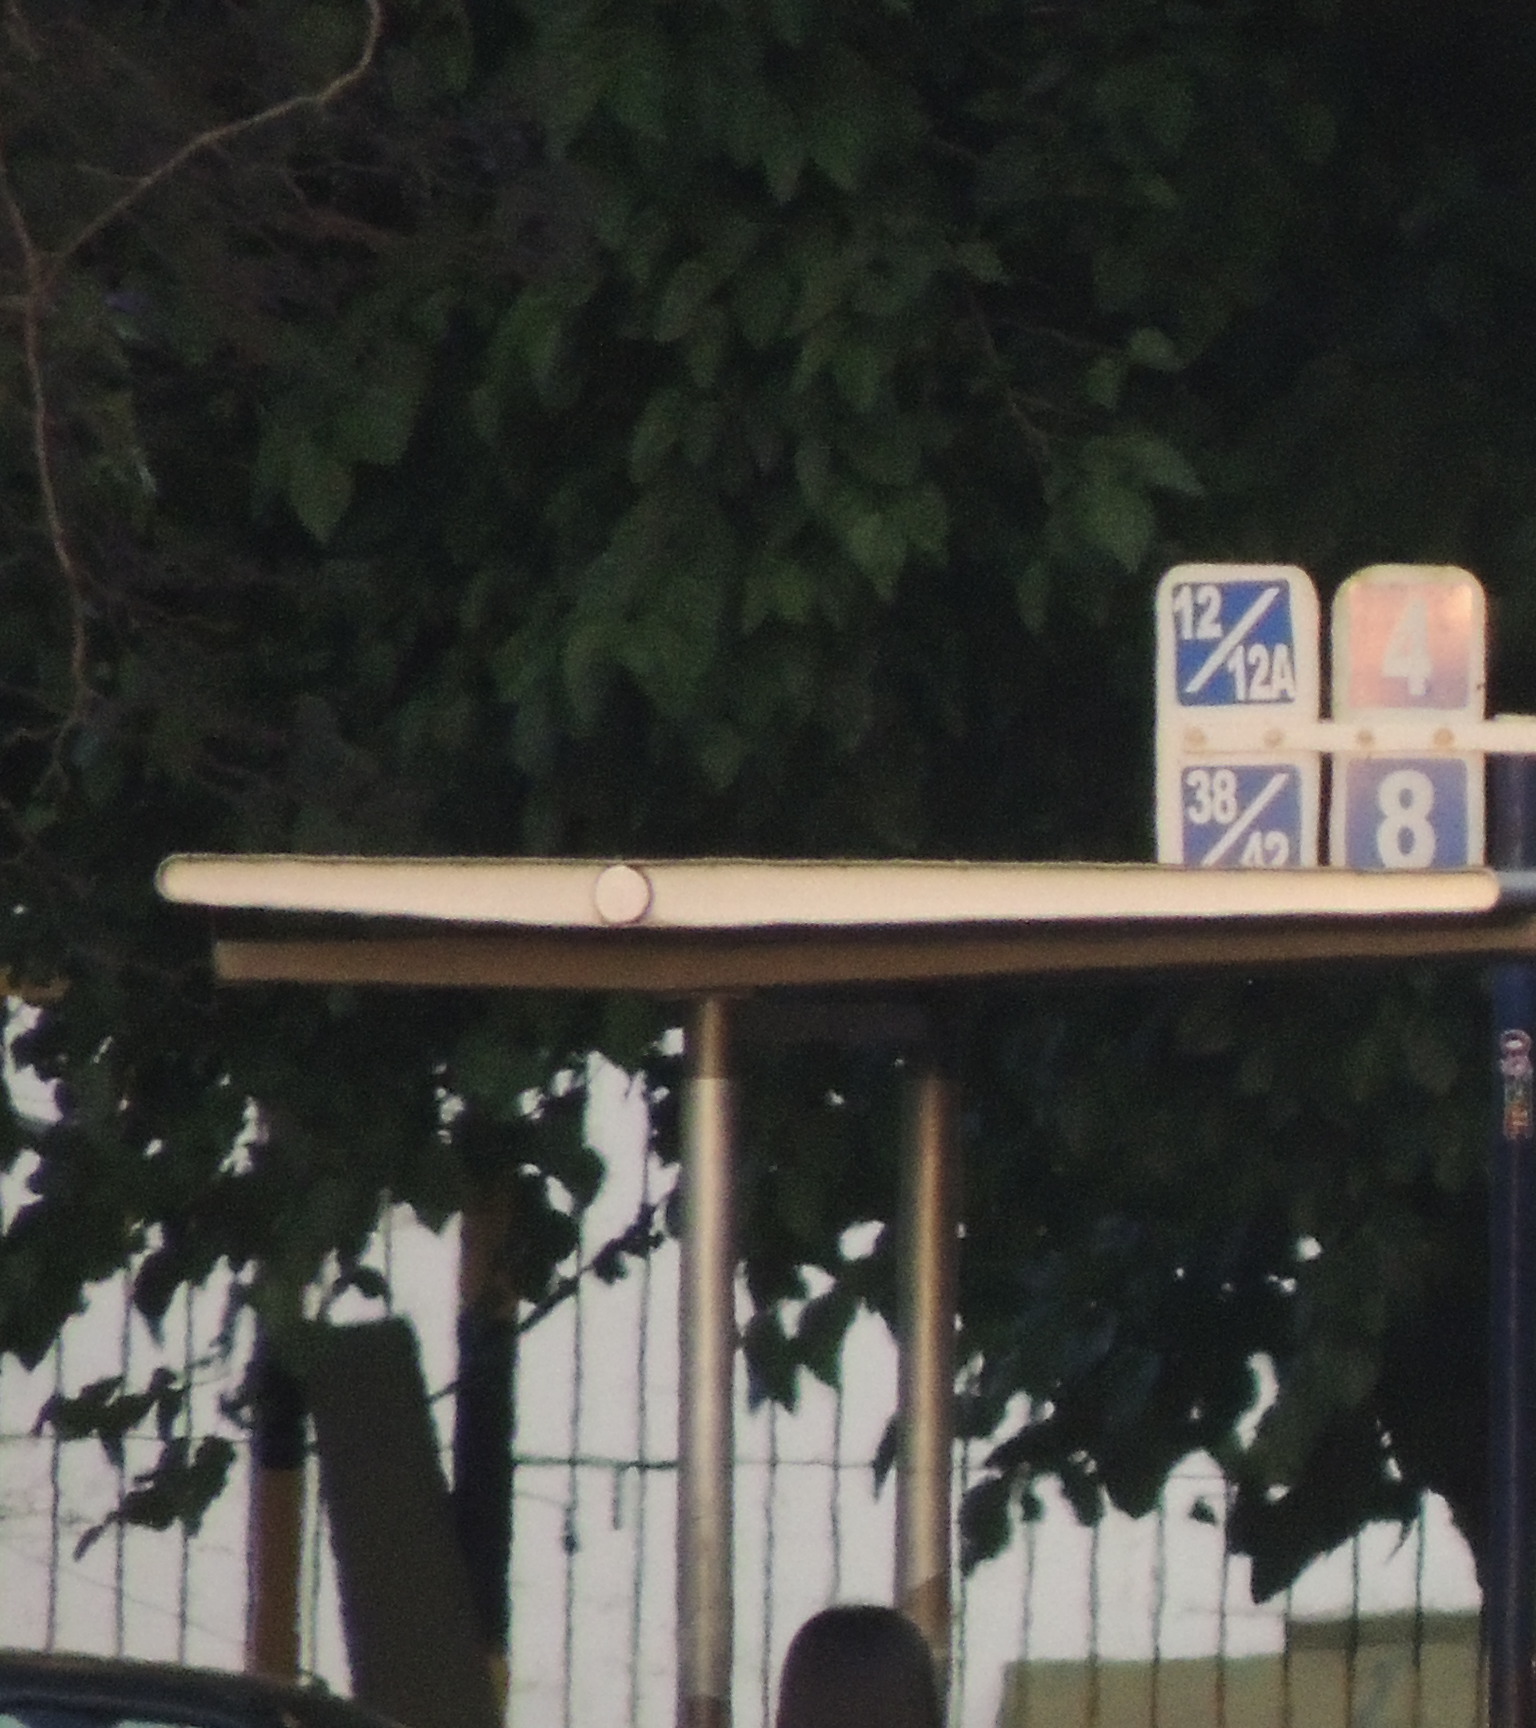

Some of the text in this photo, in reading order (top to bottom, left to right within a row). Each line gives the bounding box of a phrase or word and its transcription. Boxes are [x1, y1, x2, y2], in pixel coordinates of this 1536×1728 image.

[1174, 586, 1222, 640] 12
[1227, 644, 1296, 700] 12A
[1382, 600, 1432, 696] 4
[1185, 769, 1238, 825] 38
[1376, 769, 1436, 868] 8
